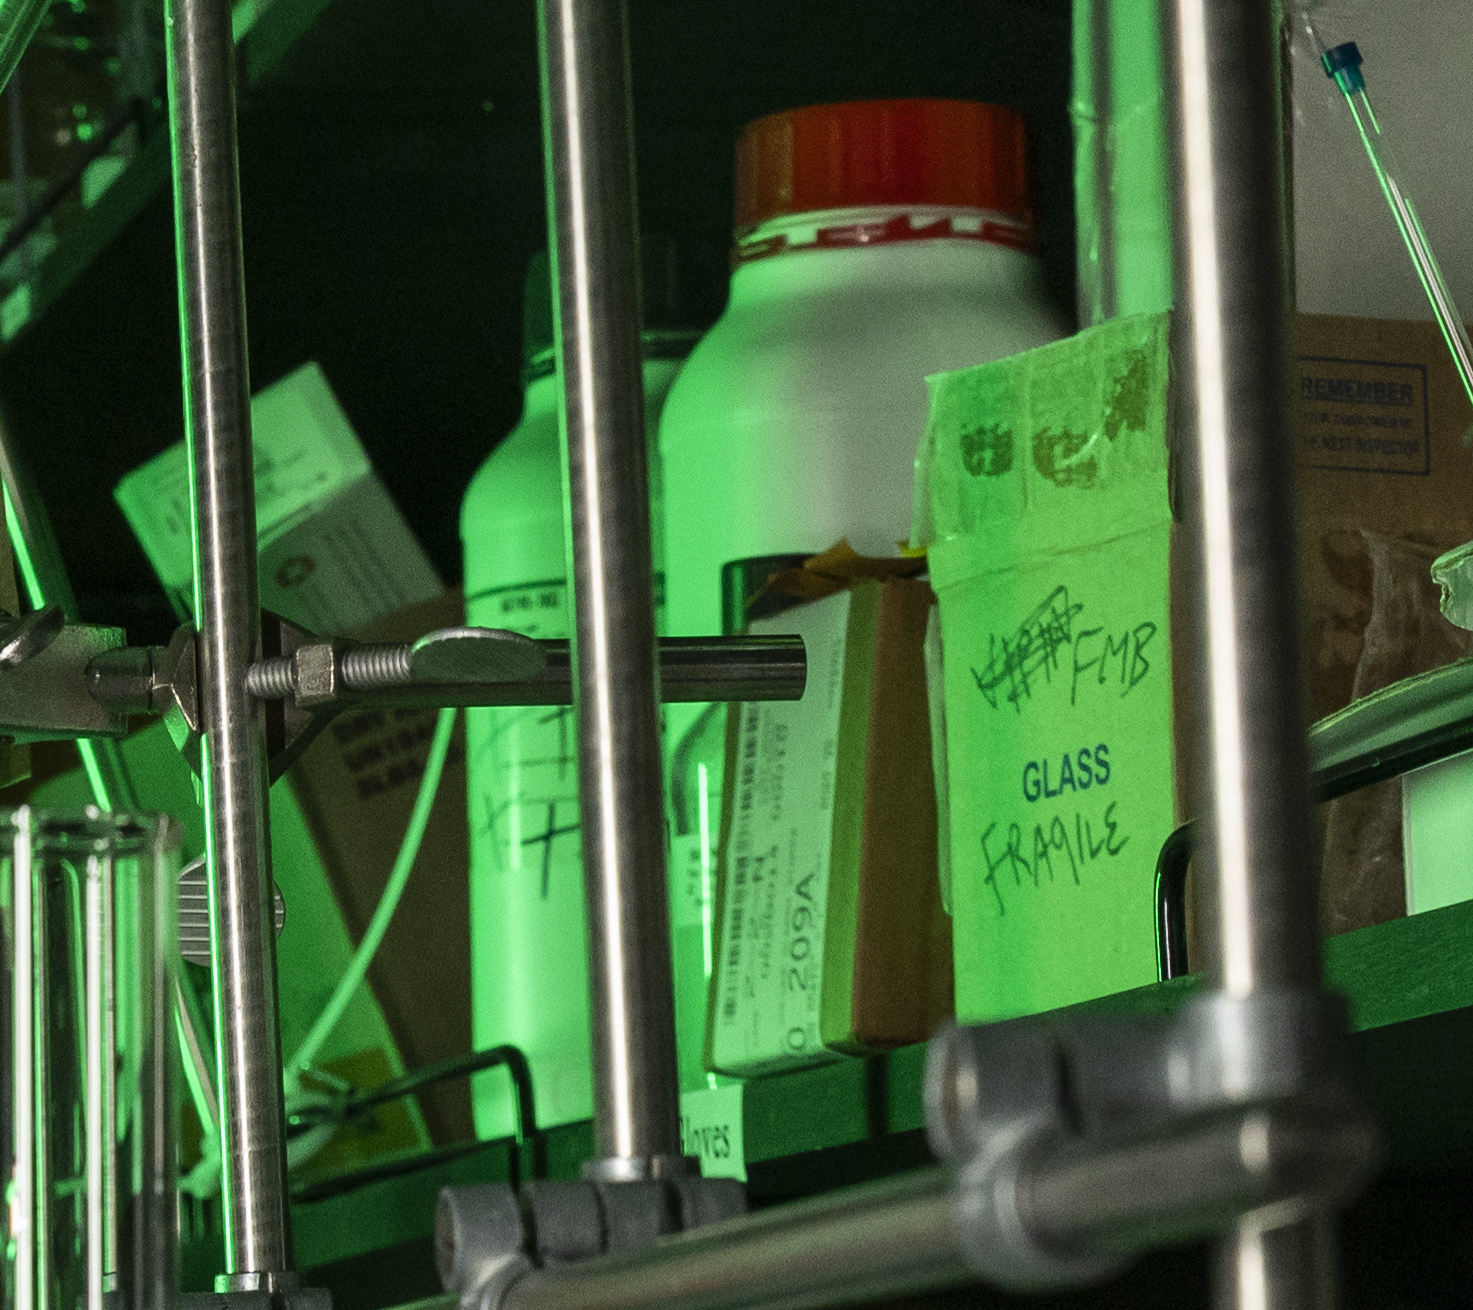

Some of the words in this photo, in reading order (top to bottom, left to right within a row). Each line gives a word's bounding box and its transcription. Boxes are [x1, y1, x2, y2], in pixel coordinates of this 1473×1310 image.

[1302, 377, 1413, 405] REMEMBER
[1022, 743, 1111, 803] GLASS
[680, 1115, 732, 1159] loves
